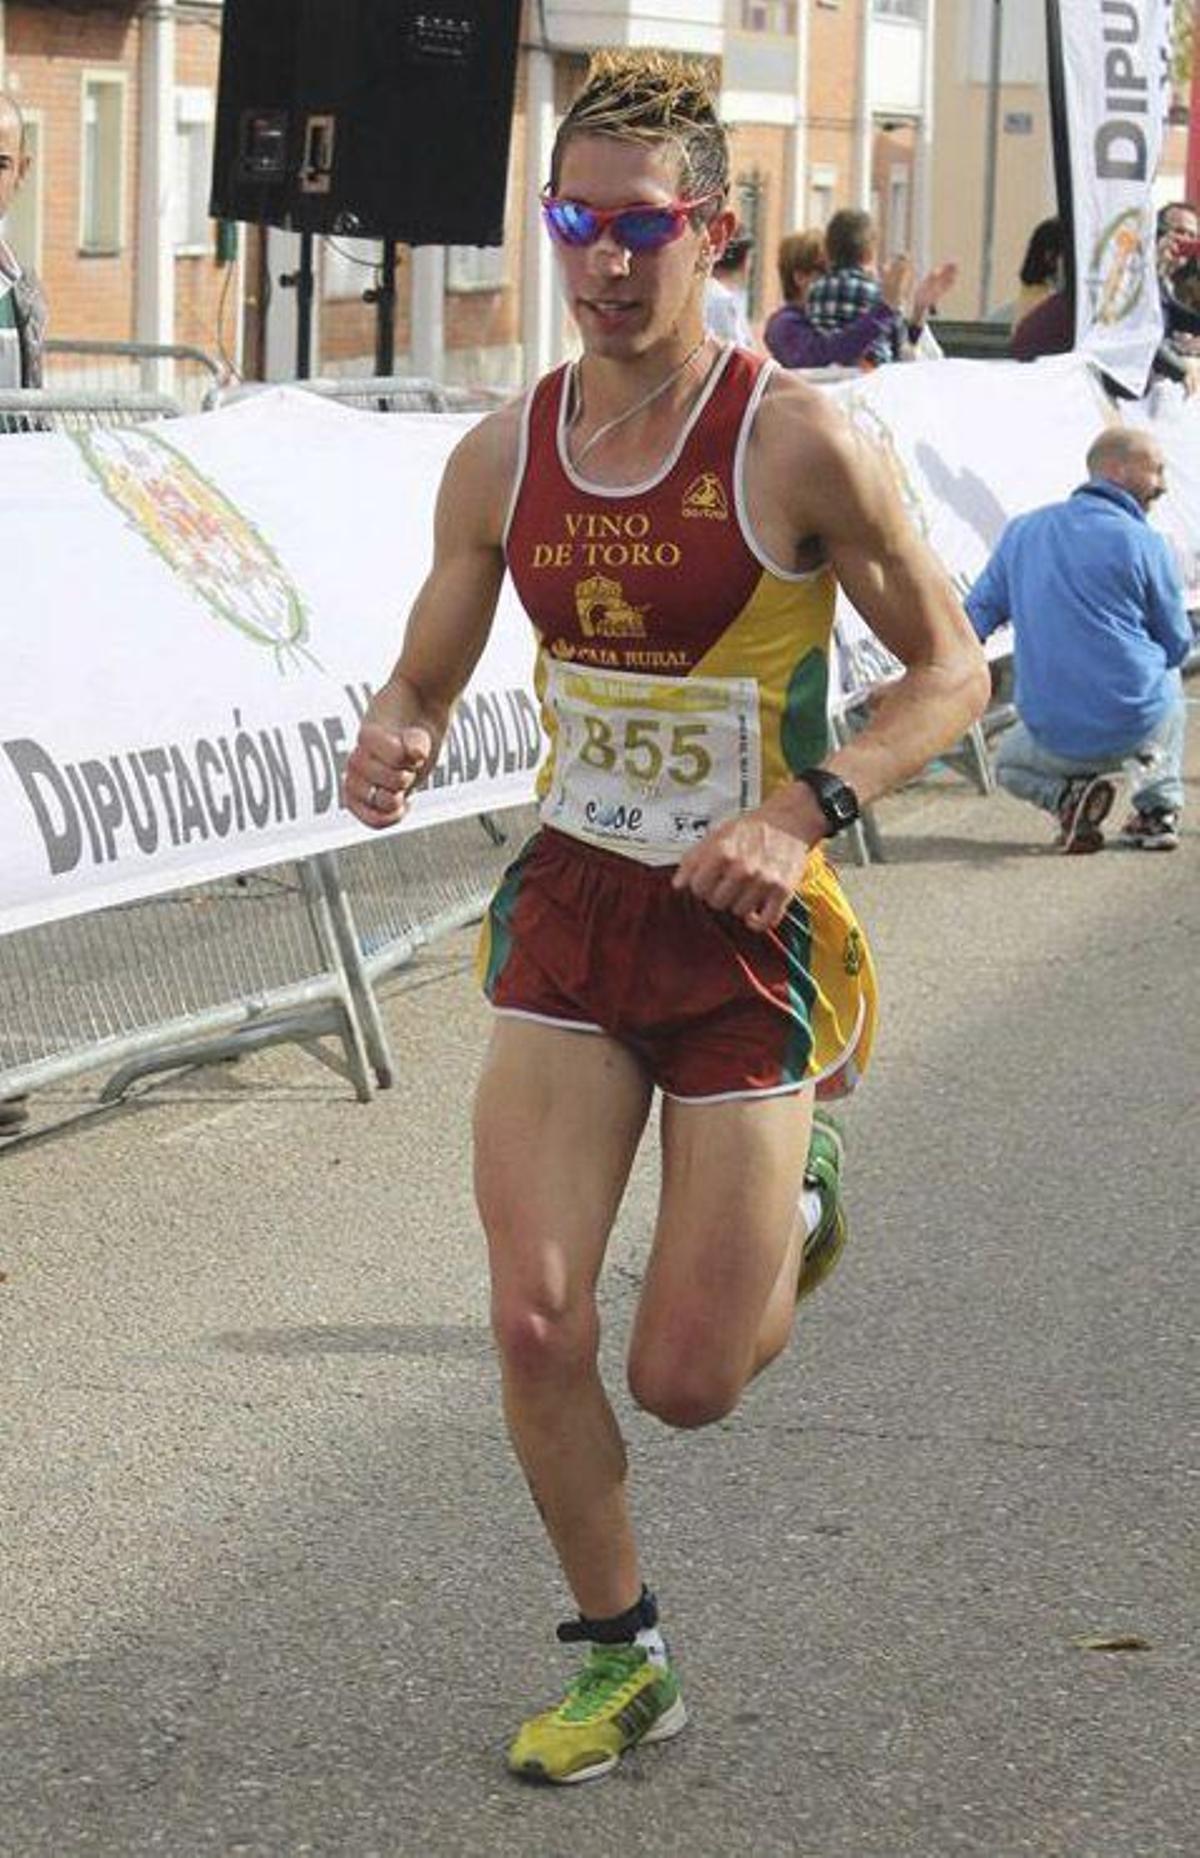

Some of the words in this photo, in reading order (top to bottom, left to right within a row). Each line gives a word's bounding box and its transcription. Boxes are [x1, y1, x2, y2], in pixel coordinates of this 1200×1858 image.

[565, 513, 650, 538] VINO
[533, 545, 572, 568] DE
[579, 542, 681, 567] TORO
[625, 651, 692, 667] RURAL
[579, 714, 713, 787] 855
[2, 708, 297, 876] DIPUTACIÓN
